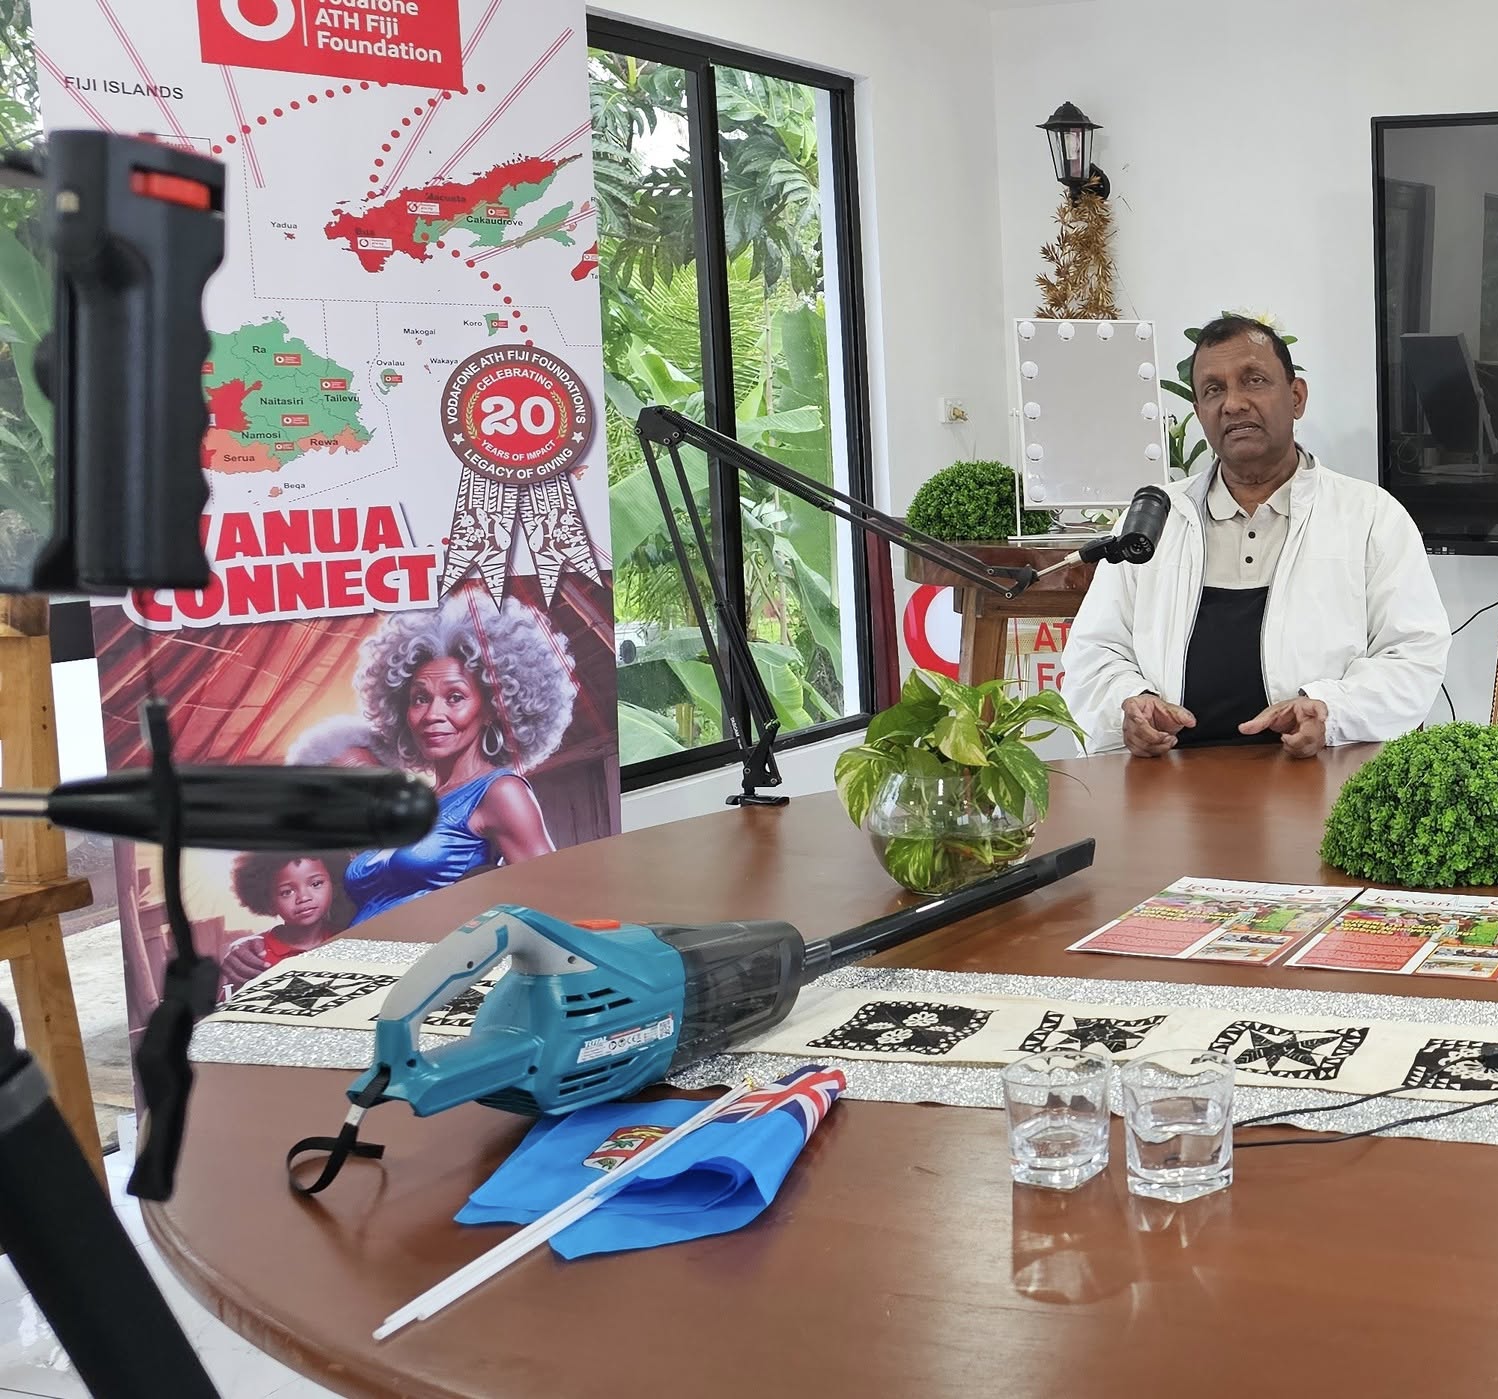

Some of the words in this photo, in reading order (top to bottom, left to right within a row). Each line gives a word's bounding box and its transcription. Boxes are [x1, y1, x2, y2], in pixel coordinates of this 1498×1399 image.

[318, 0, 419, 16] afone
[315, 8, 360, 31] ATH
[366, 14, 399, 39] Fiji
[317, 31, 442, 63] Foundation
[64, 76, 97, 91] FIJI
[103, 80, 184, 100] ISLANDS
[270, 221, 298, 229] Yadua
[466, 215, 524, 227] Cakaudrove
[463, 320, 483, 328] Koro
[403, 328, 436, 336] Makogai
[252, 345, 267, 354] Ra
[376, 359, 405, 367] Ovalau
[476, 368, 554, 391] CELEBRATING
[447, 362, 481, 425] VODAFONE
[480, 351, 505, 368] ATH
[507, 350, 529, 362] FIJI
[531, 353, 587, 424] FOUNDATION'S
[260, 397, 304, 406] Naitasiri
[324, 394, 360, 402] Tailevu
[480, 395, 555, 436] 20
[241, 431, 281, 440] Namosi
[310, 438, 339, 446] Rewa
[481, 439, 509, 460] YEARS
[511, 452, 525, 461] OF
[527, 440, 556, 460] IMPACT
[223, 454, 255, 462] Serua
[464, 449, 514, 478] LEGACY
[516, 468, 534, 479] OF
[536, 448, 573, 476] GIVING
[283, 482, 306, 490] Beqa
[200, 506, 404, 561] ANUA
[1034, 622, 1073, 653] AT
